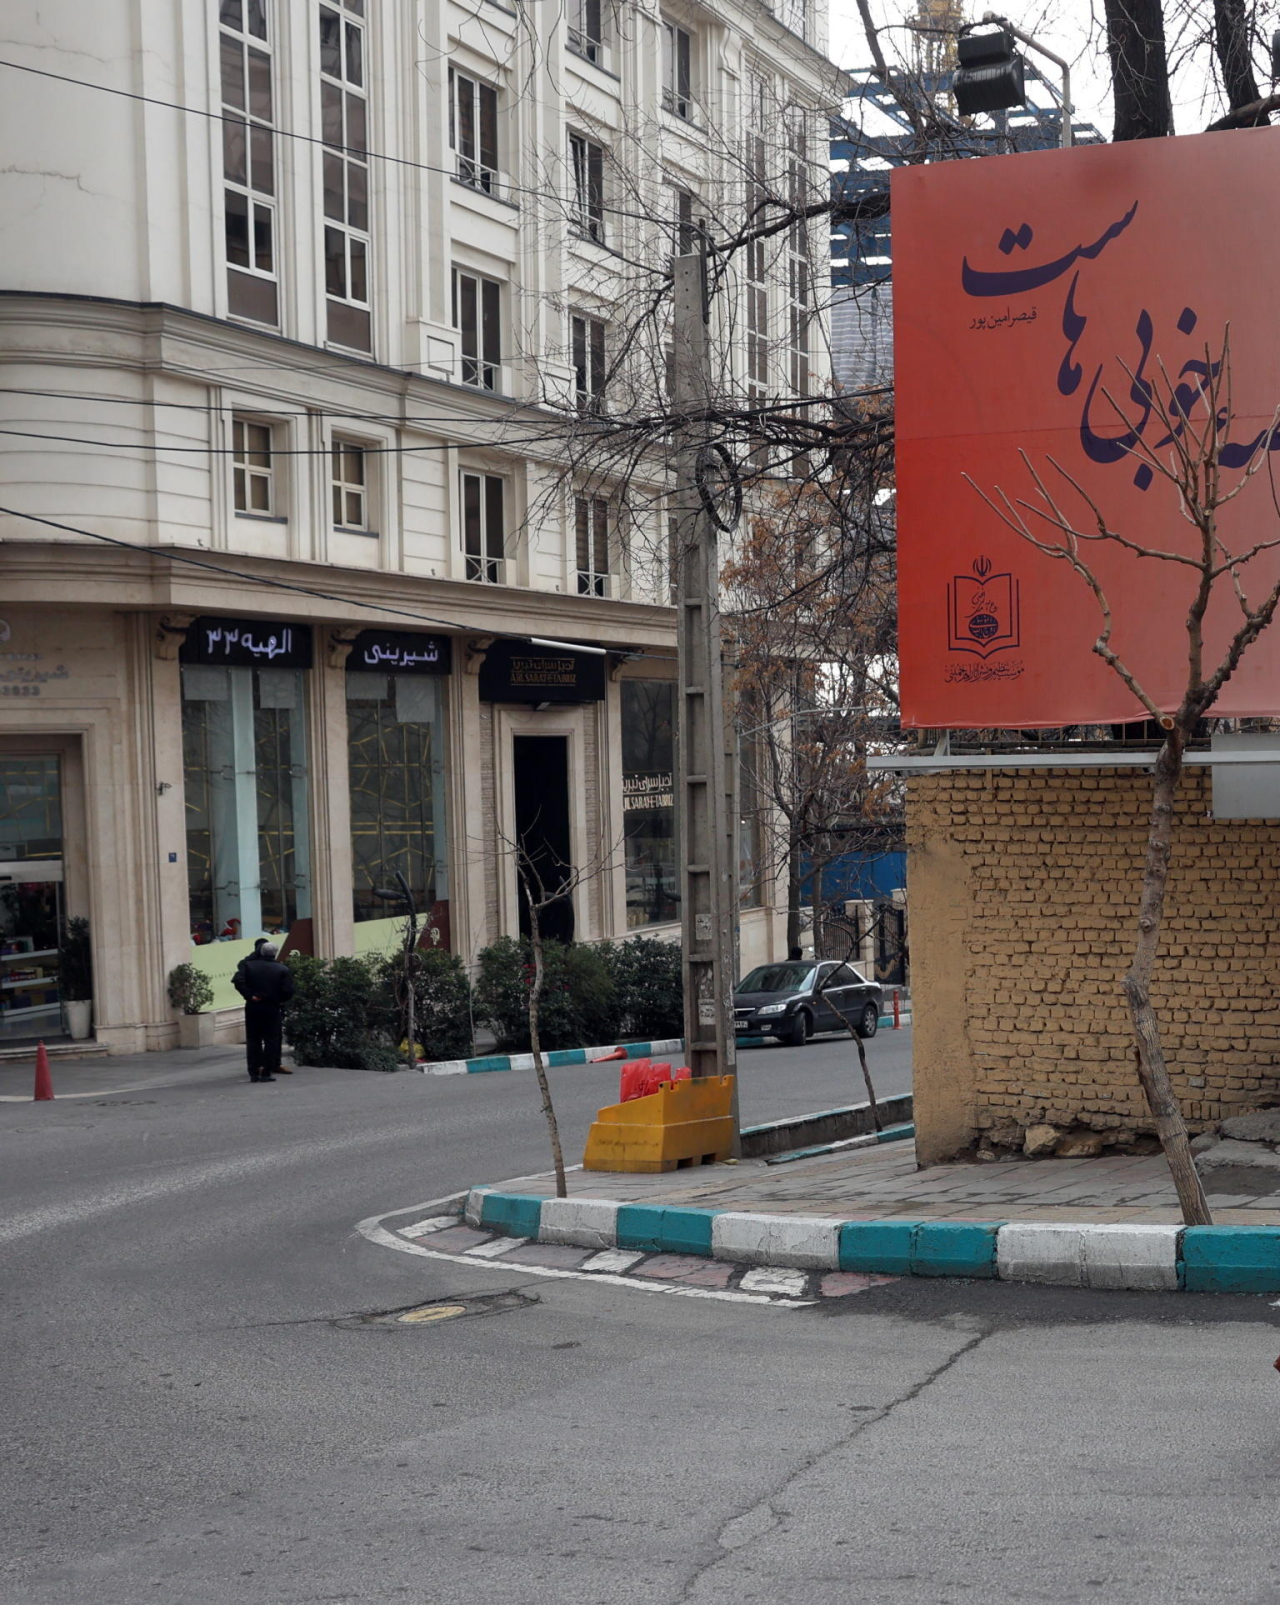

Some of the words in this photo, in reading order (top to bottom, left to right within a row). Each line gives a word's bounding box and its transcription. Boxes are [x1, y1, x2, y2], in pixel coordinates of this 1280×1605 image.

[1008, 306, 1037, 328] قیصر
[241, 627, 292, 659] الهیه
[364, 641, 439, 666] شیرینی
